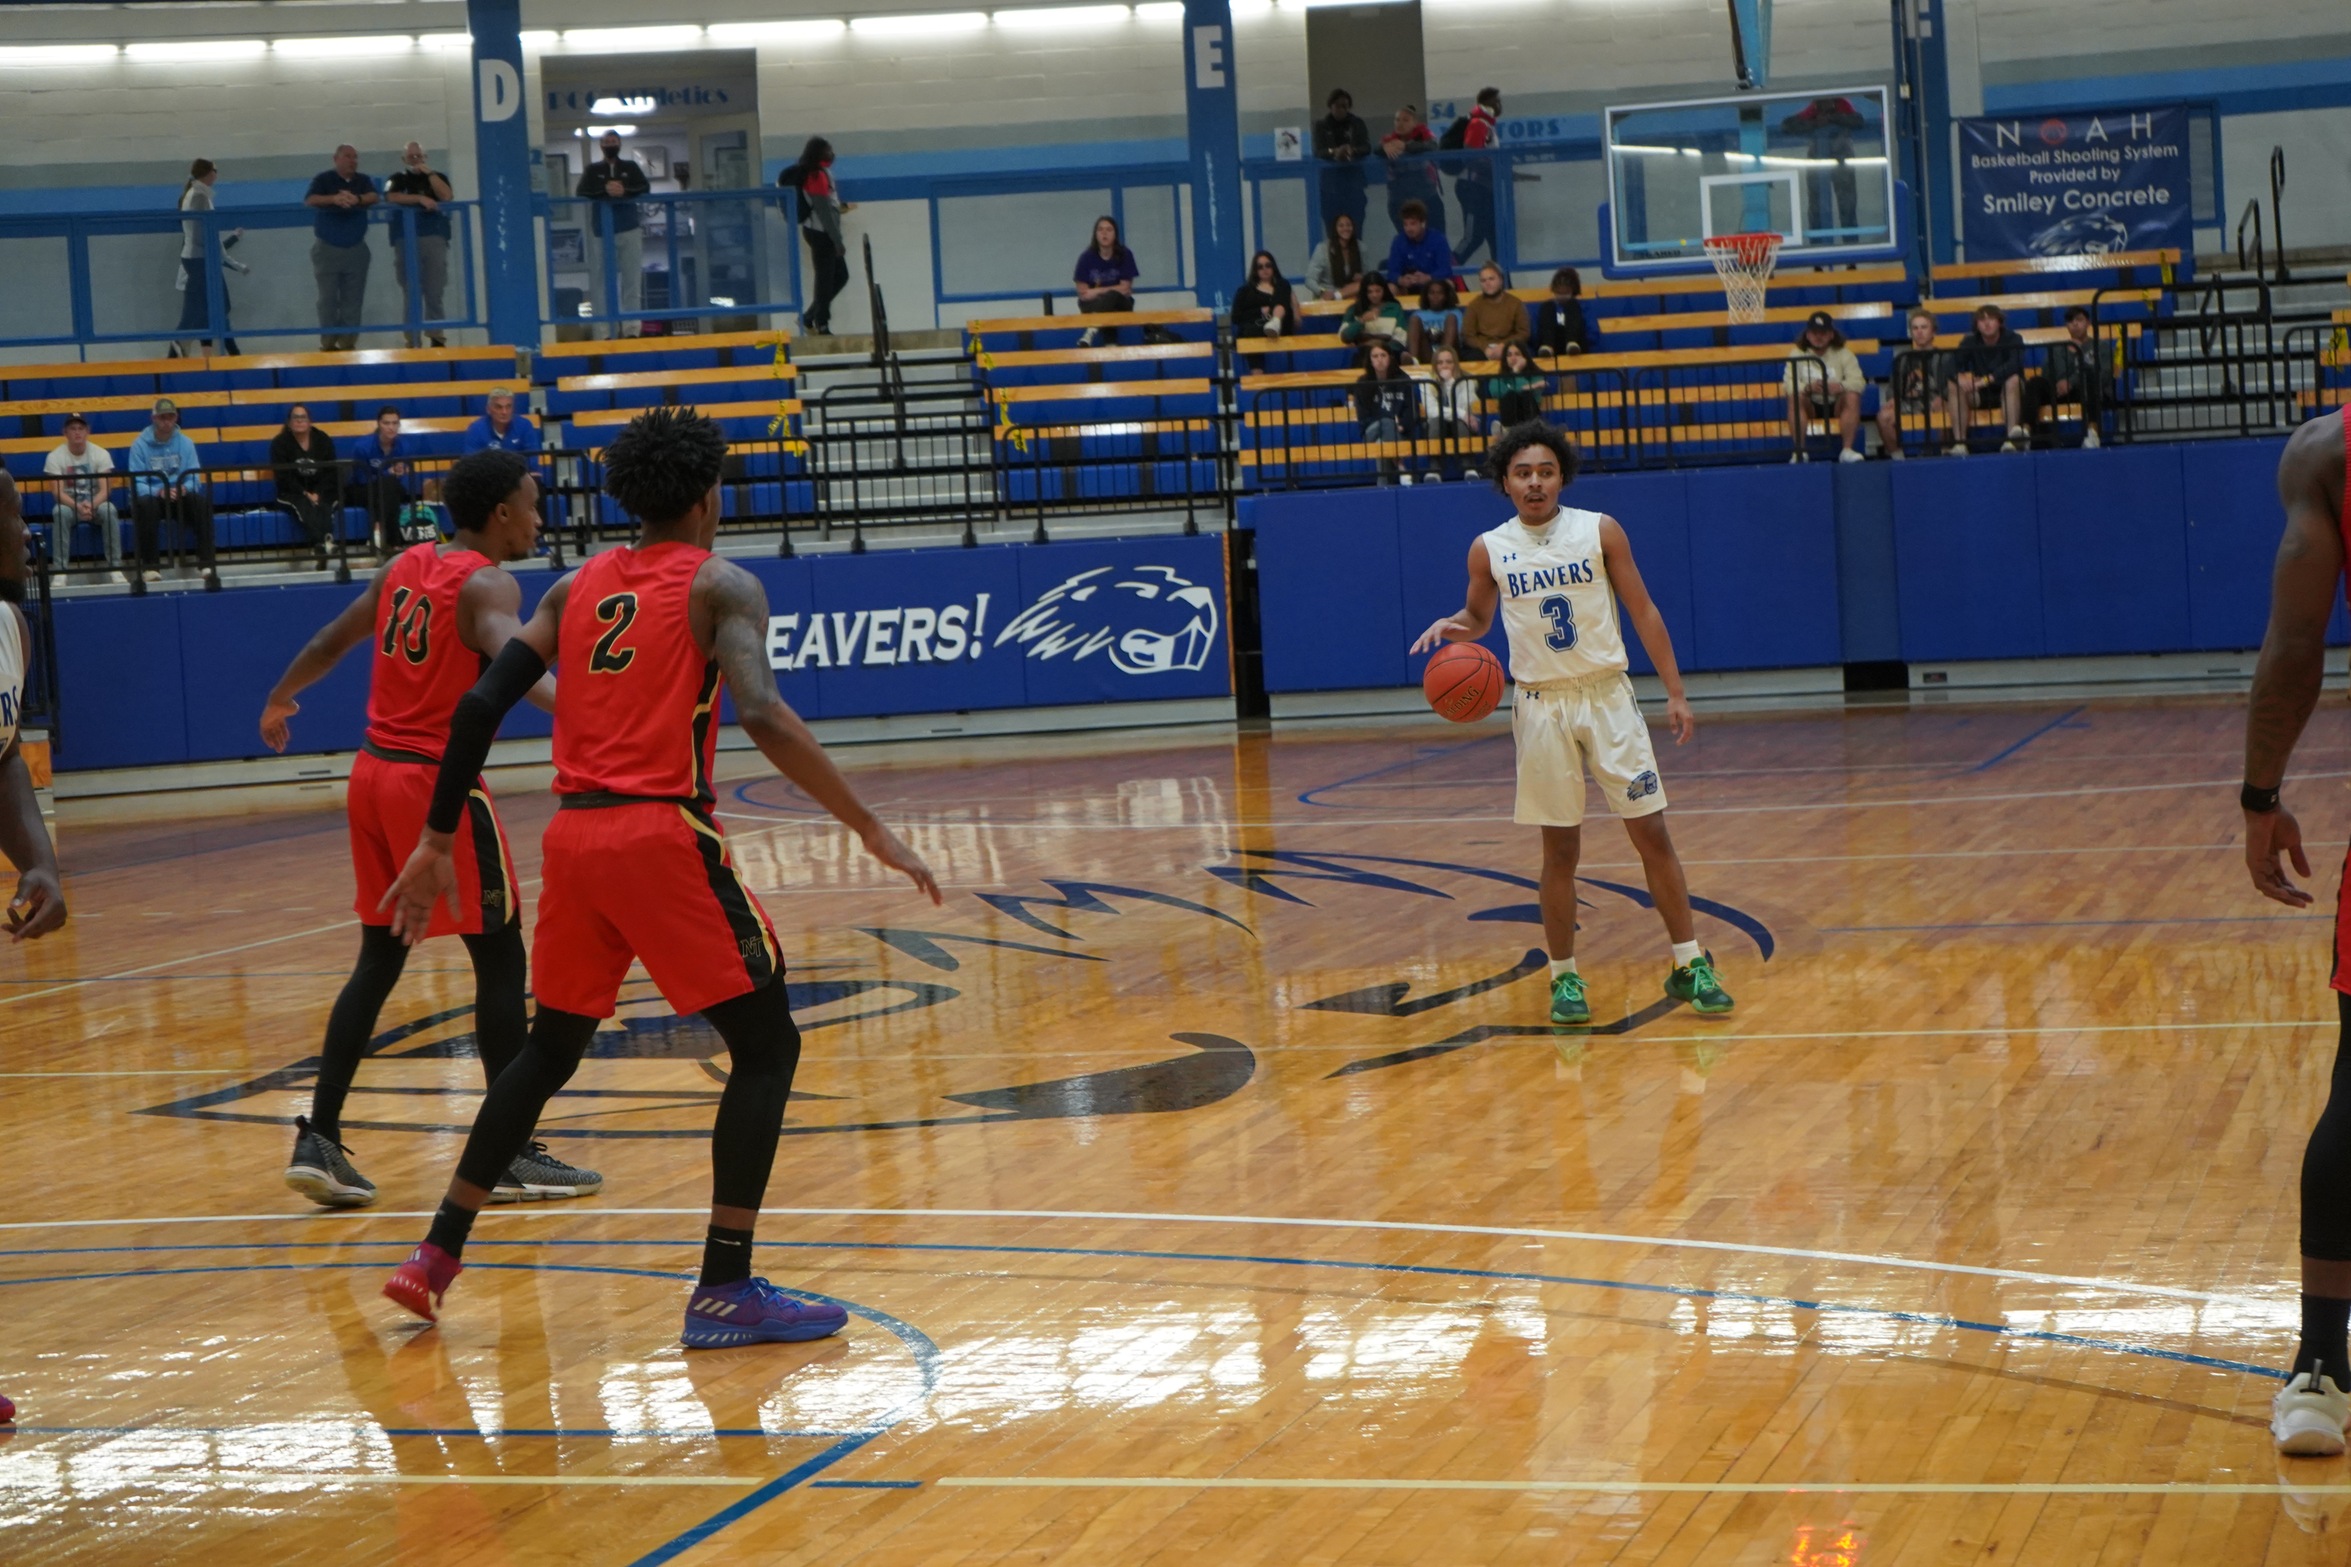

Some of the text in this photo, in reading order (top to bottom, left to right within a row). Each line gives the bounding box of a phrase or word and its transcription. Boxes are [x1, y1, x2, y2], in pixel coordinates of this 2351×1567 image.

[1193, 25, 1225, 89] E
[479, 59, 521, 122] D
[1971, 144, 2179, 169] Basketball Shooting System
[2029, 166, 2121, 184] Provided by
[1983, 184, 2171, 215] Smiley Concrete
[399, 524, 437, 541] VNS
[1506, 558, 1594, 599] BEAVERS
[381, 585, 432, 666] 10
[588, 591, 639, 674] 2
[765, 592, 991, 672] EAVERS!
[1539, 593, 1578, 653] 3
